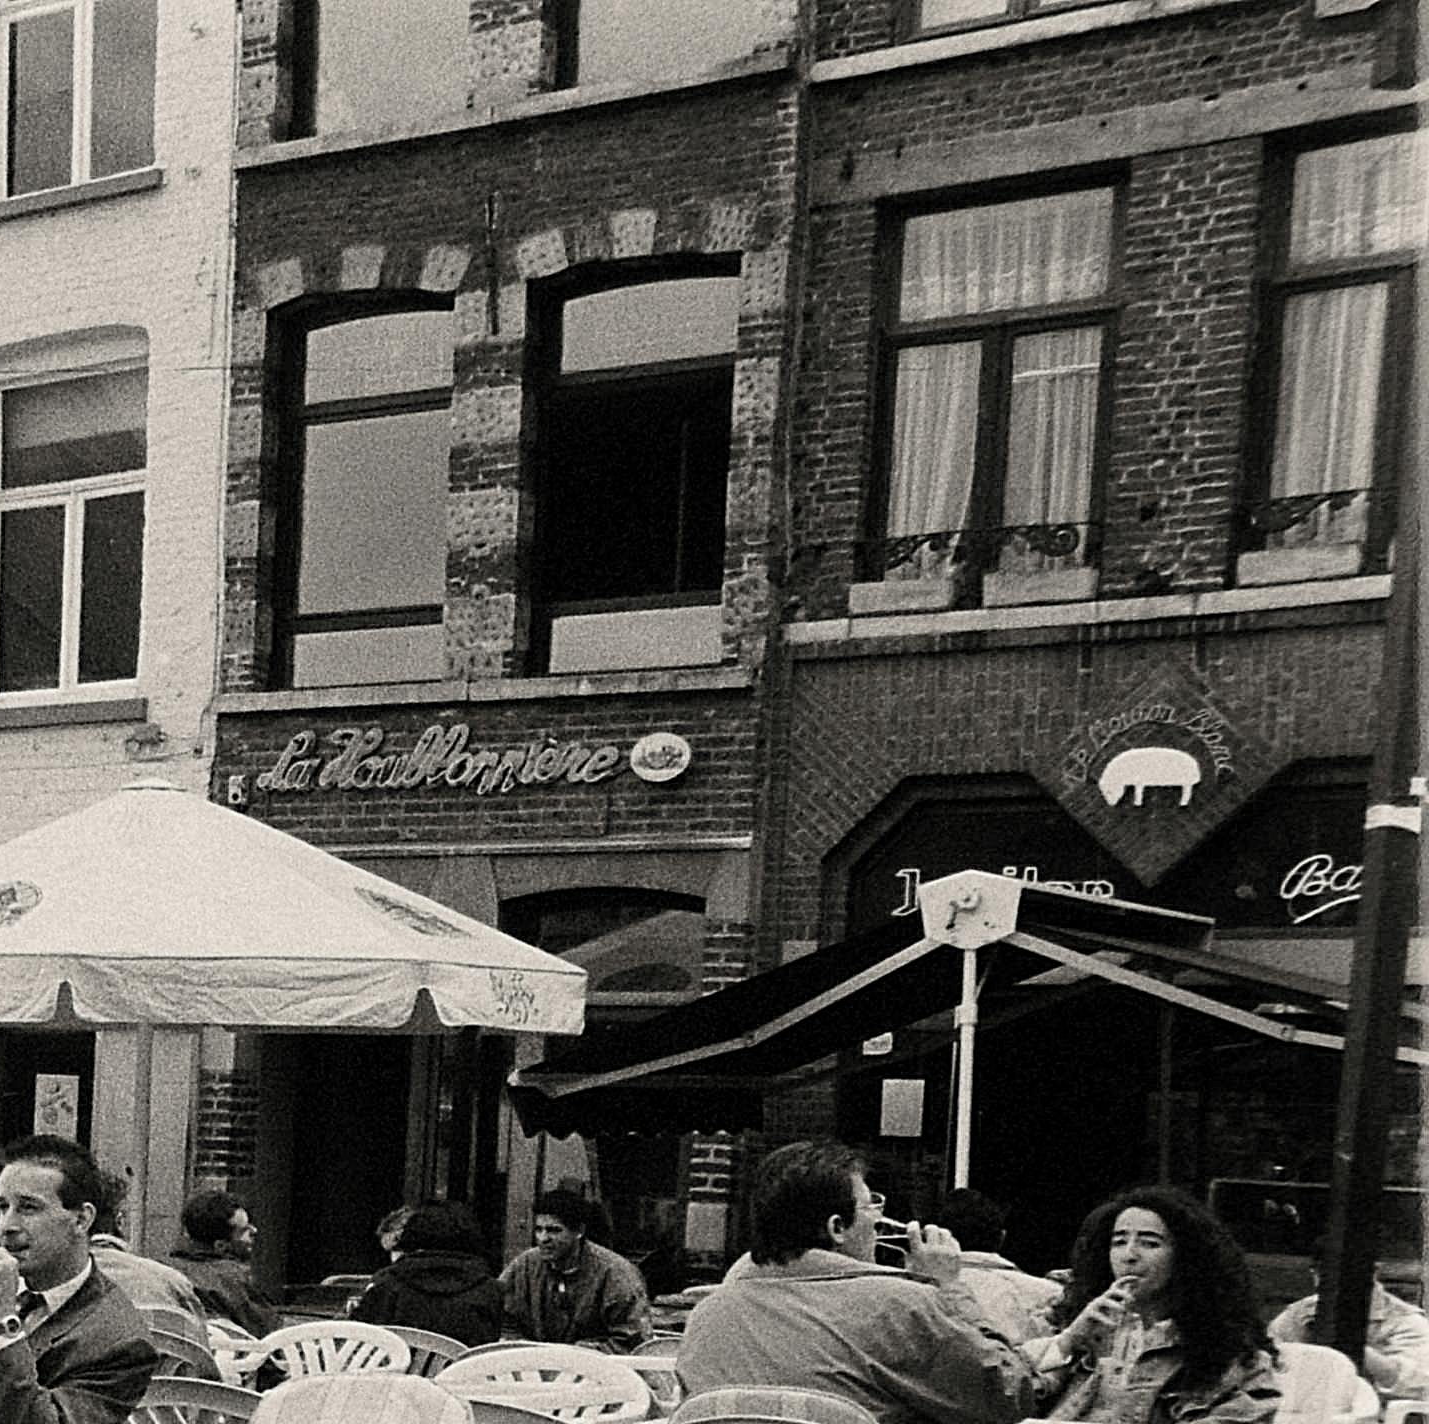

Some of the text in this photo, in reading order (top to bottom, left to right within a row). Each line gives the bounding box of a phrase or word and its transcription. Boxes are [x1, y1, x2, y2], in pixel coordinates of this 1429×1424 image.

[256, 729, 322, 792] La
[1180, 707, 1235, 777] Blanc
[1280, 853, 1365, 899] Ba
